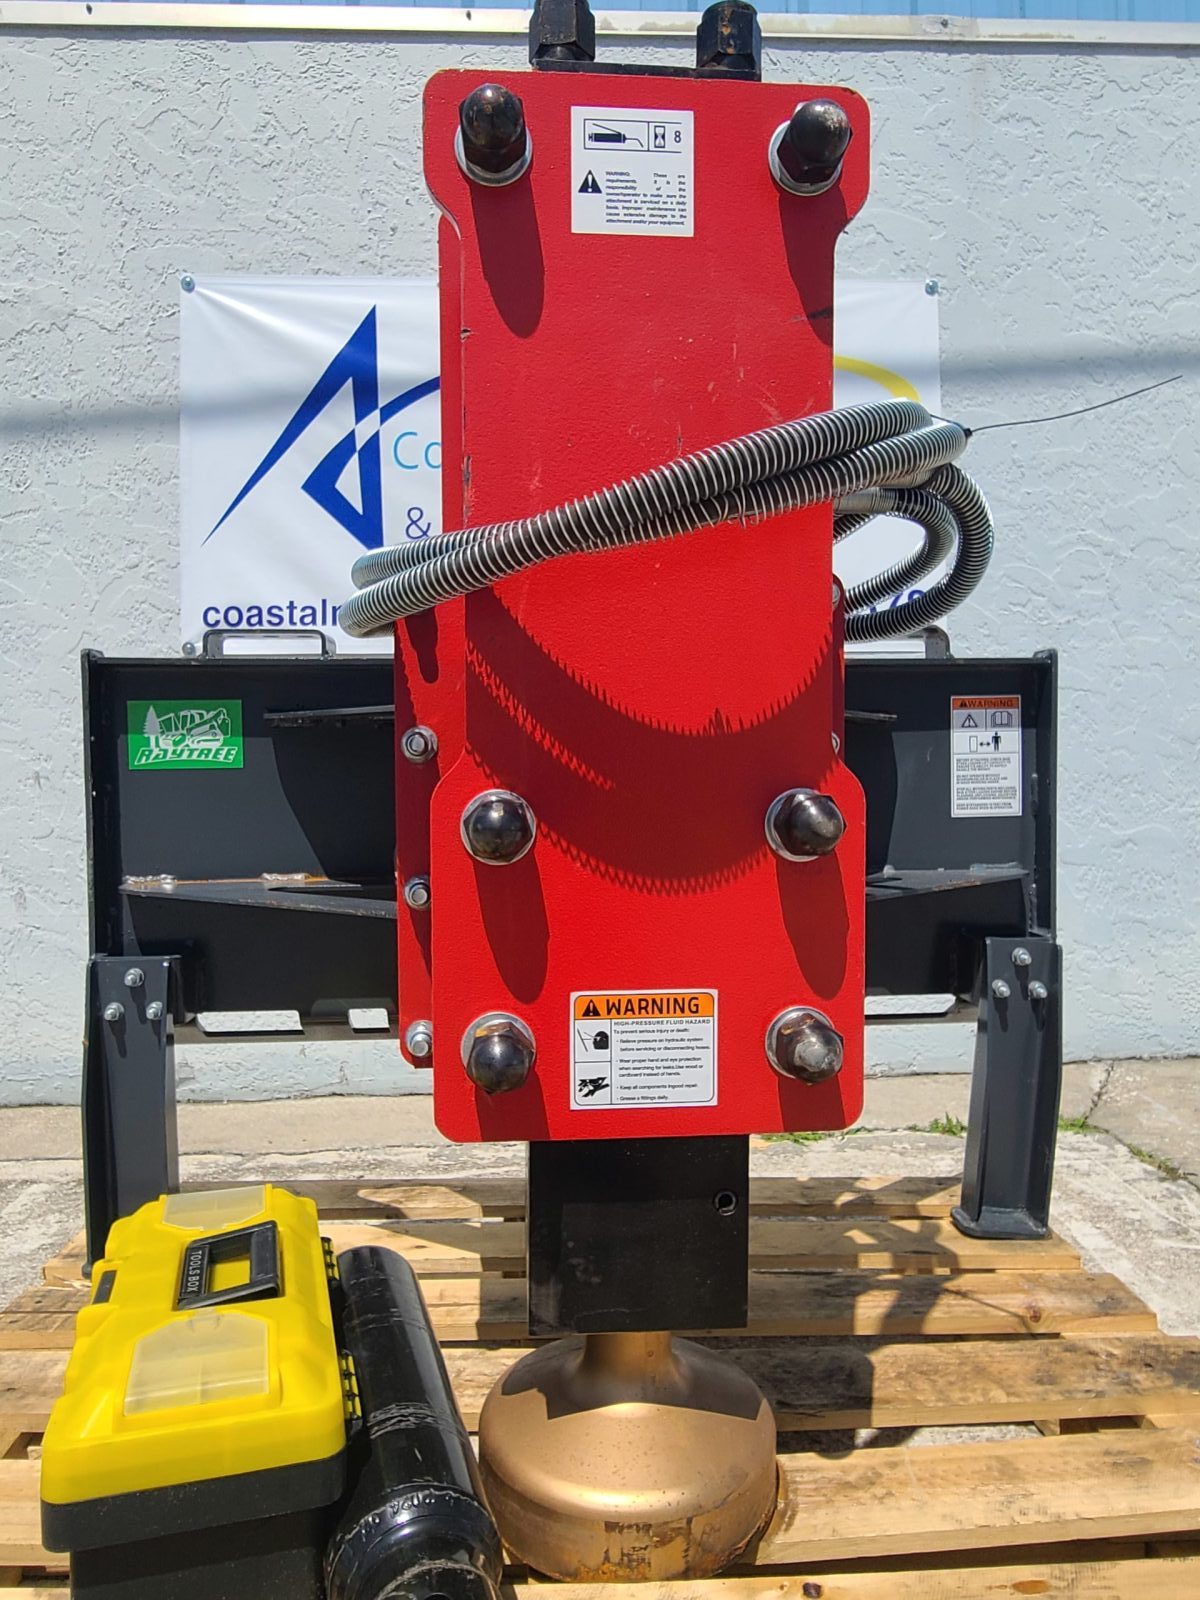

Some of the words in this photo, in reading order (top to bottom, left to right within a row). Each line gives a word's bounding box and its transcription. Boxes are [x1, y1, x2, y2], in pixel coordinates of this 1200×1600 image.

[674, 130, 682, 144] 8
[405, 507, 431, 540] &
[968, 699, 1014, 708] WARNING
[134, 746, 238, 766] RAYTREE
[605, 996, 700, 1016] WARNING
[188, 1250, 202, 1276] TOOLS
[186, 1276, 200, 1292] BOX
